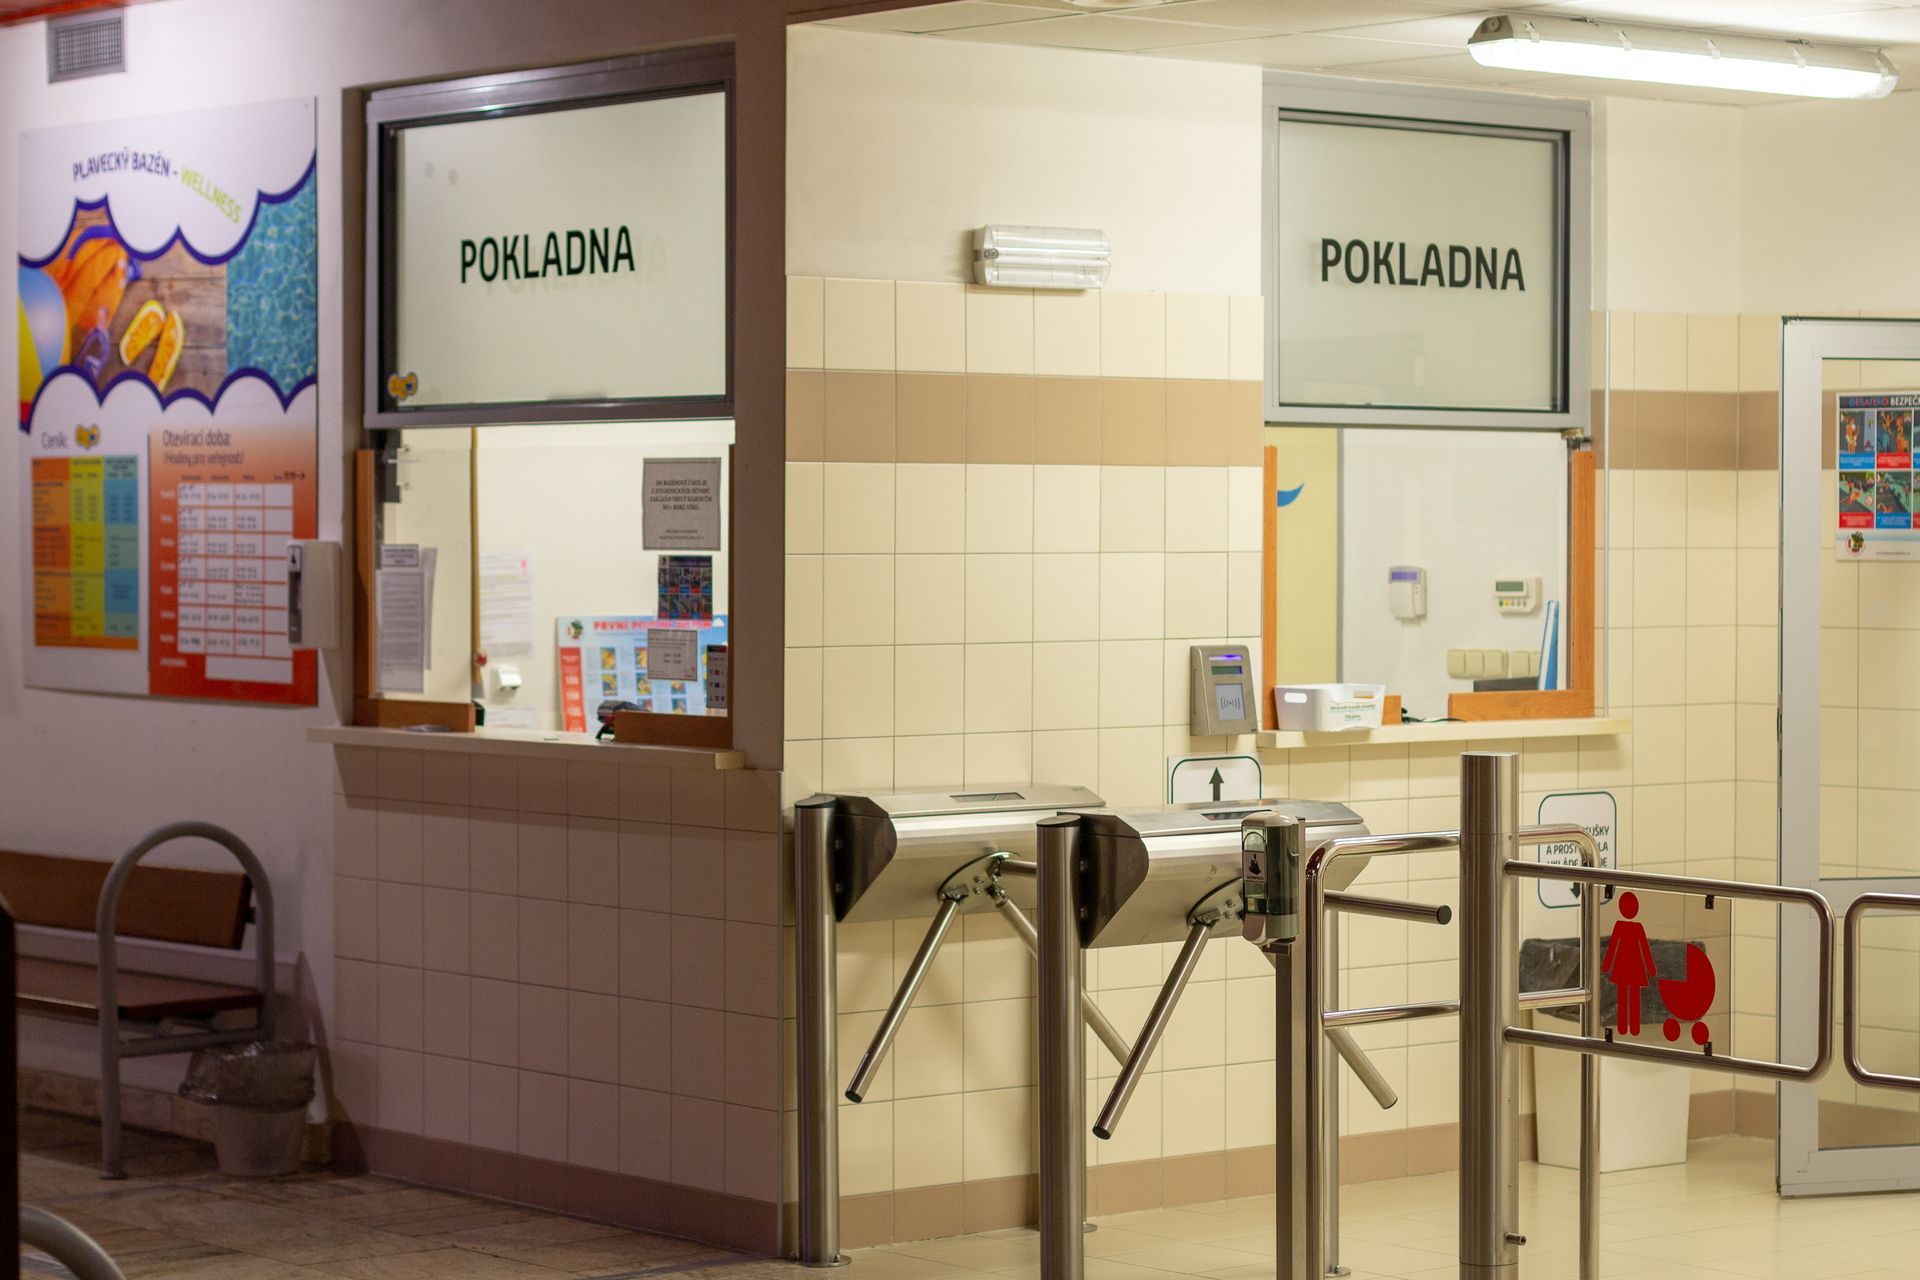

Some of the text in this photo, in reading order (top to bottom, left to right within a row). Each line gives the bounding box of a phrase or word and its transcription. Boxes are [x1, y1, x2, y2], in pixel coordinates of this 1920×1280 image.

[72, 146, 129, 182] PLAVECKÝ
[131, 150, 171, 177] BAZÉN
[181, 165, 243, 224] WELLNESS
[460, 225, 635, 284] POKLADNA
[1321, 237, 1526, 292] POKLADNA
[1890, 393, 1920, 407] BEZPEČ
[1546, 845, 1552, 855] A
